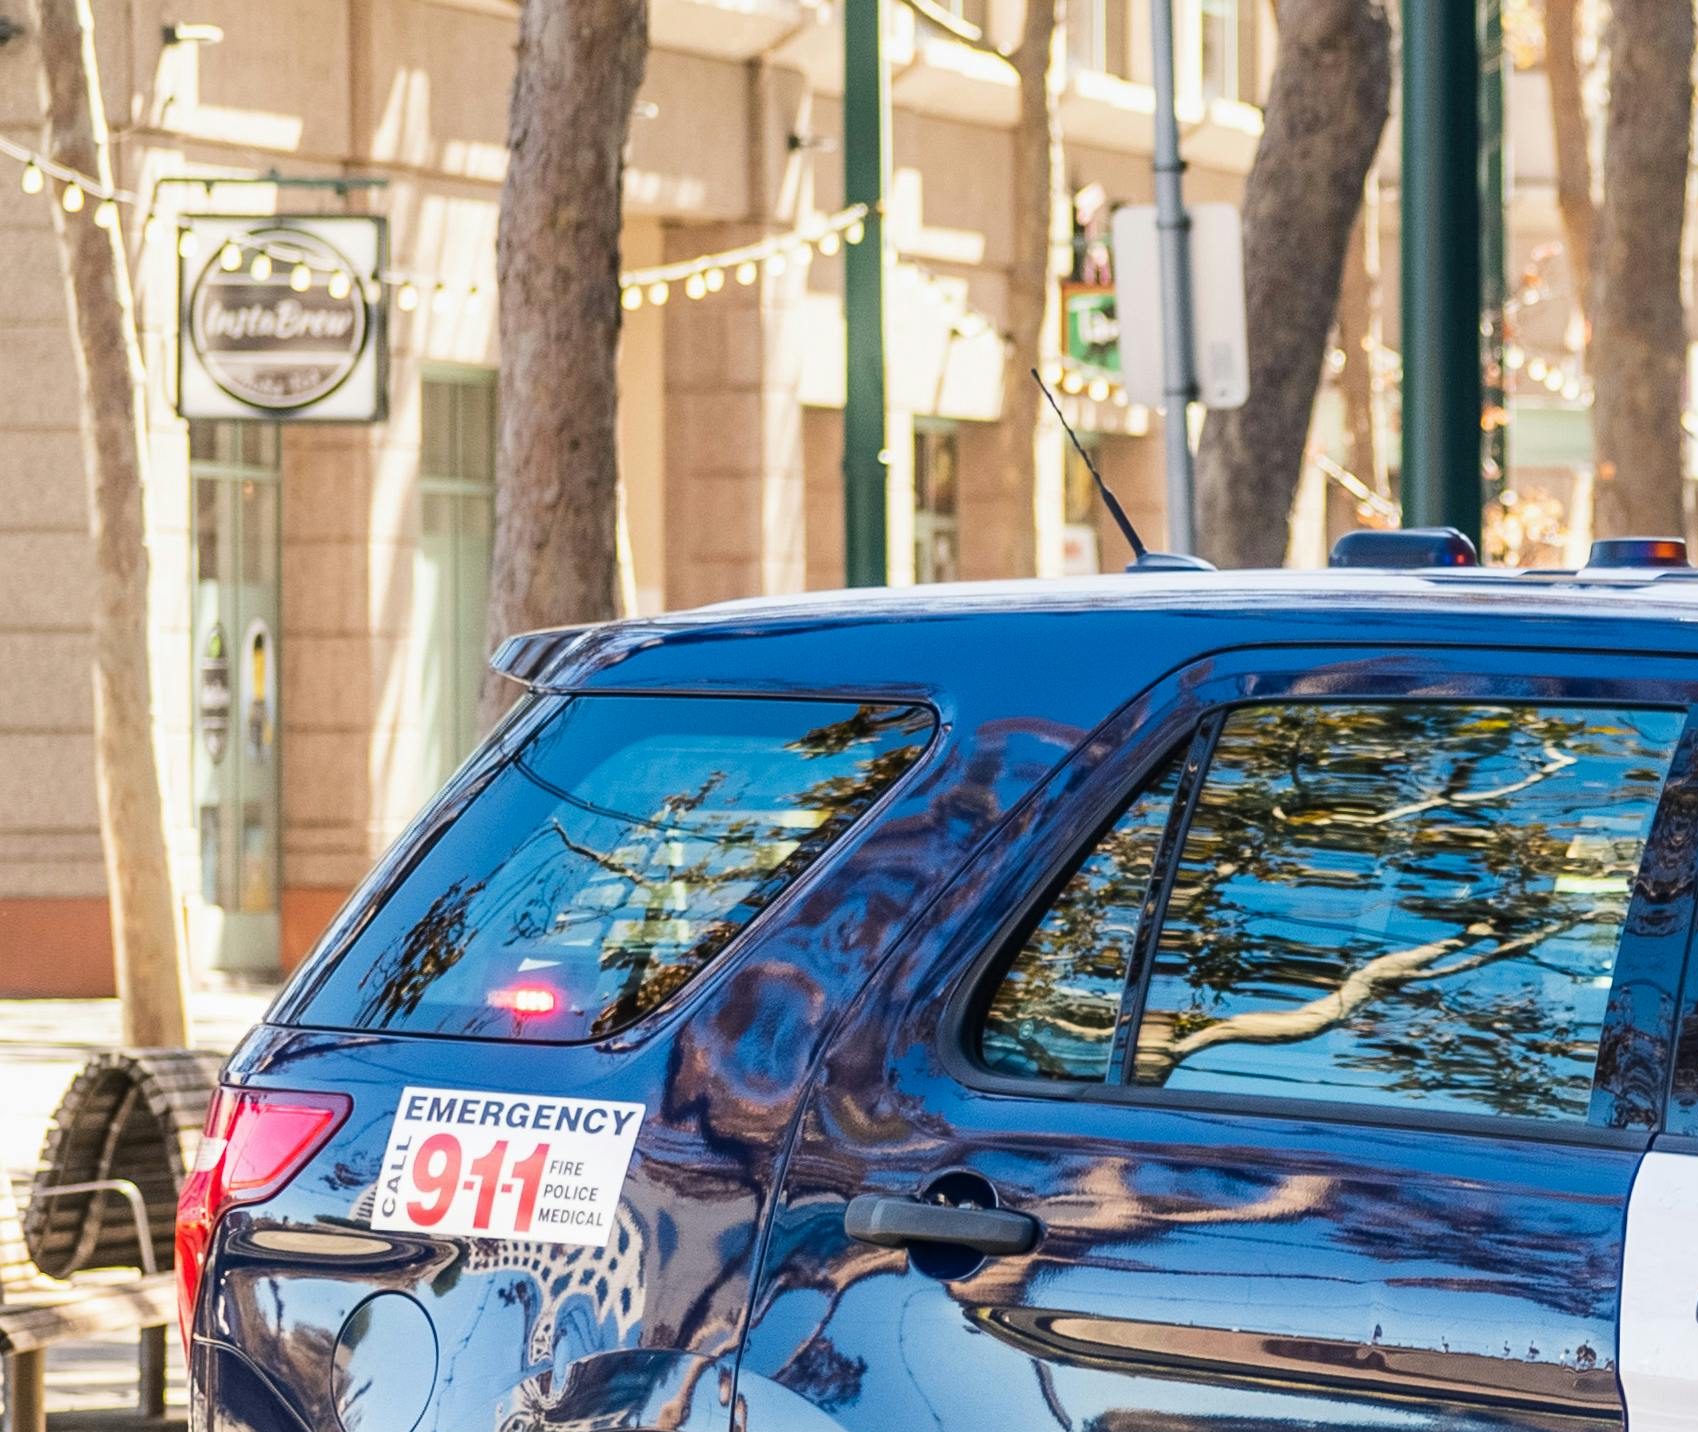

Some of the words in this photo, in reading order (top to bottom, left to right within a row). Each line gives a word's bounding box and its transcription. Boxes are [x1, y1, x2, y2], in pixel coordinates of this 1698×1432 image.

[404, 1096, 636, 1136] EMERGENCY
[382, 1135, 412, 1218] CALL
[549, 1160, 584, 1176] FIRE
[543, 1183, 599, 1202] POLICE
[538, 1208, 603, 1227] MEDICAL
